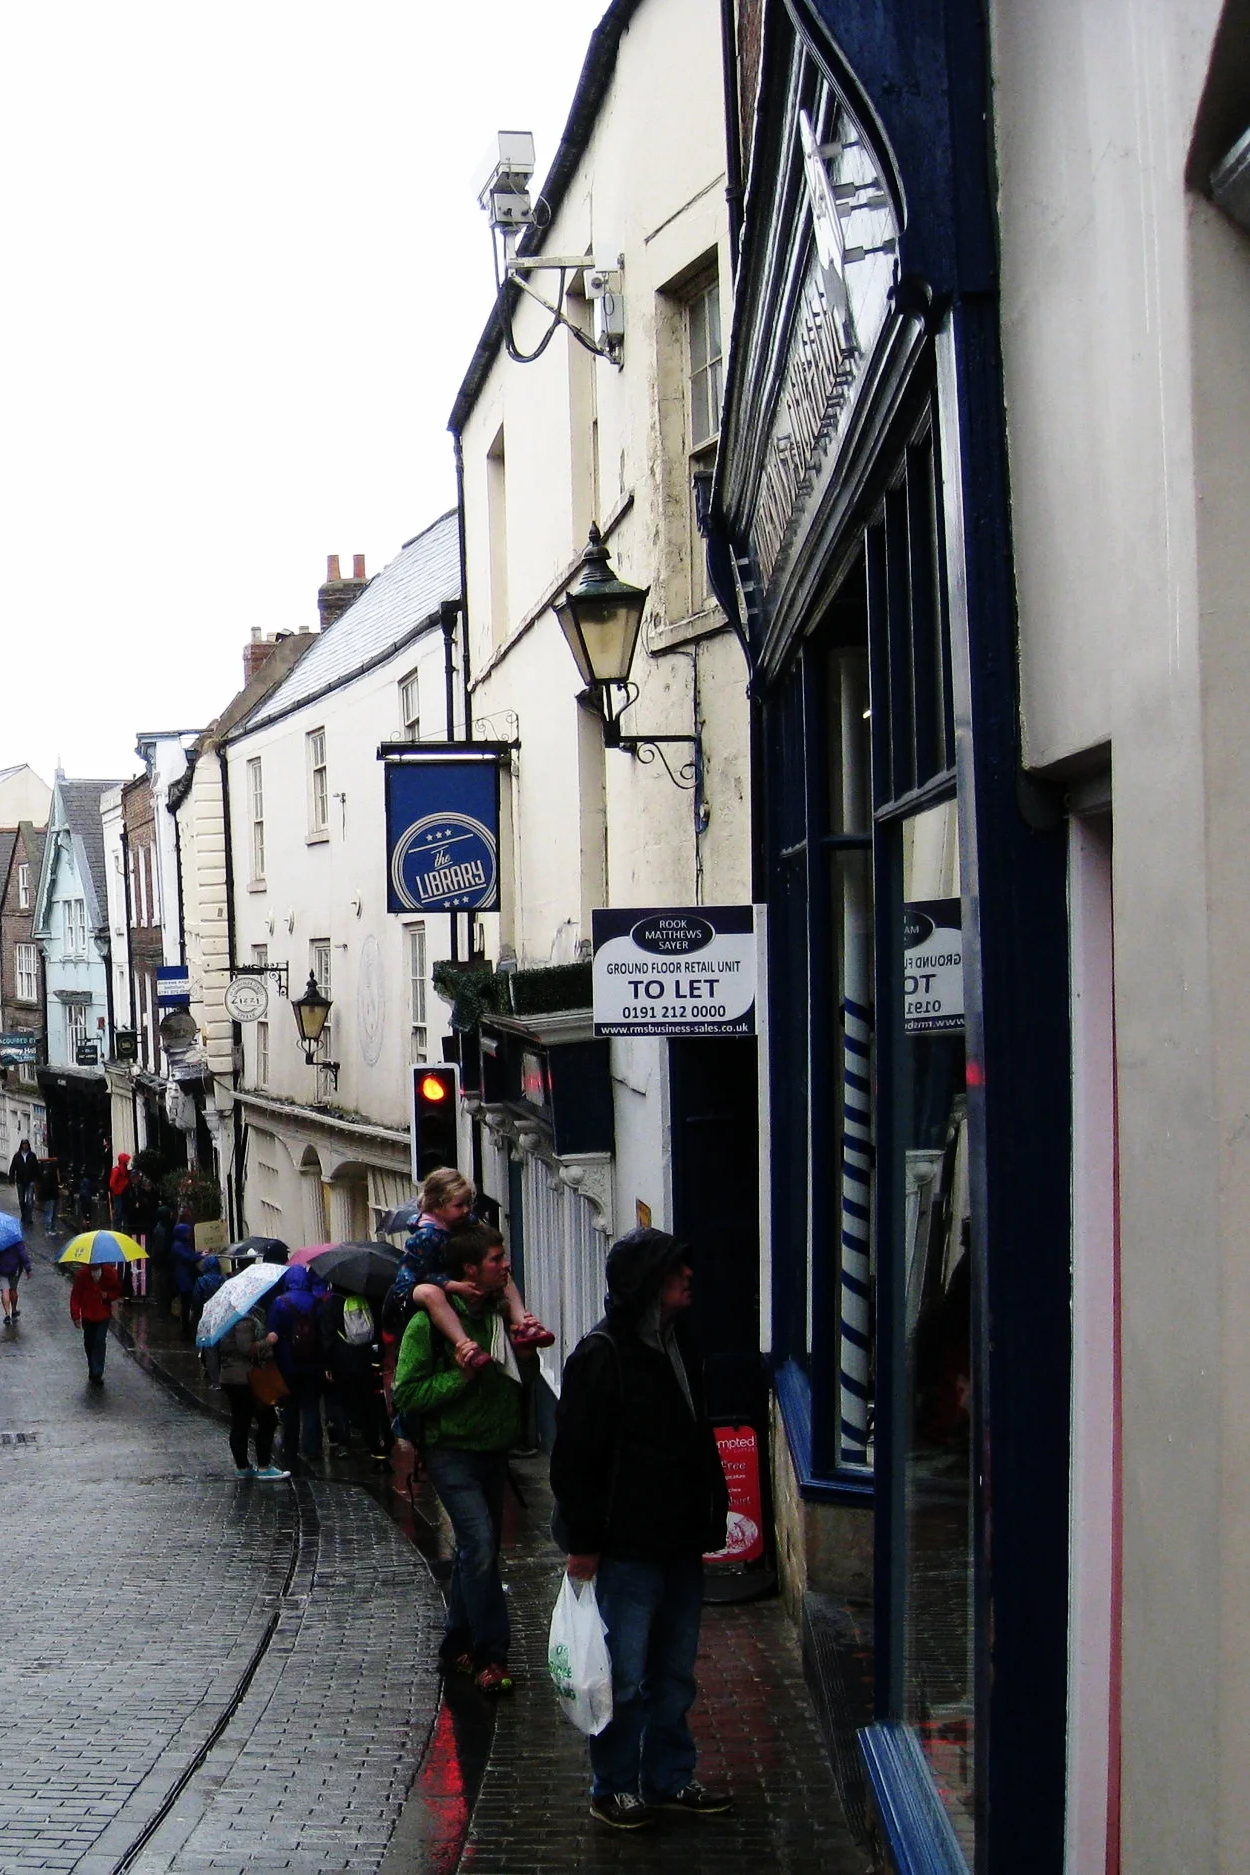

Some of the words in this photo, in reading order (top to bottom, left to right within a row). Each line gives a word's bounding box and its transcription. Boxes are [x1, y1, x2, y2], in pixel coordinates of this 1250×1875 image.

[434, 850, 451, 867] the
[415, 860, 486, 899] LIBRARY
[659, 919, 688, 929] ROOK
[645, 930, 702, 940] MATTHEWS
[658, 941, 689, 950] SAYER
[606, 963, 649, 975] GROUND
[651, 962, 682, 974] FLOOR
[684, 961, 715, 974] RETAIL
[717, 961, 741, 973] UNIT
[628, 980, 665, 1000] TO
[674, 979, 720, 999] LET
[622, 1006, 657, 1019] 0191
[661, 1006, 687, 1018] 212
[691, 1005, 726, 1018] 0000
[600, 1022, 749, 1035] www.rmsbusiness-sales.co.uk
[717, 1436, 754, 1448] mpted
